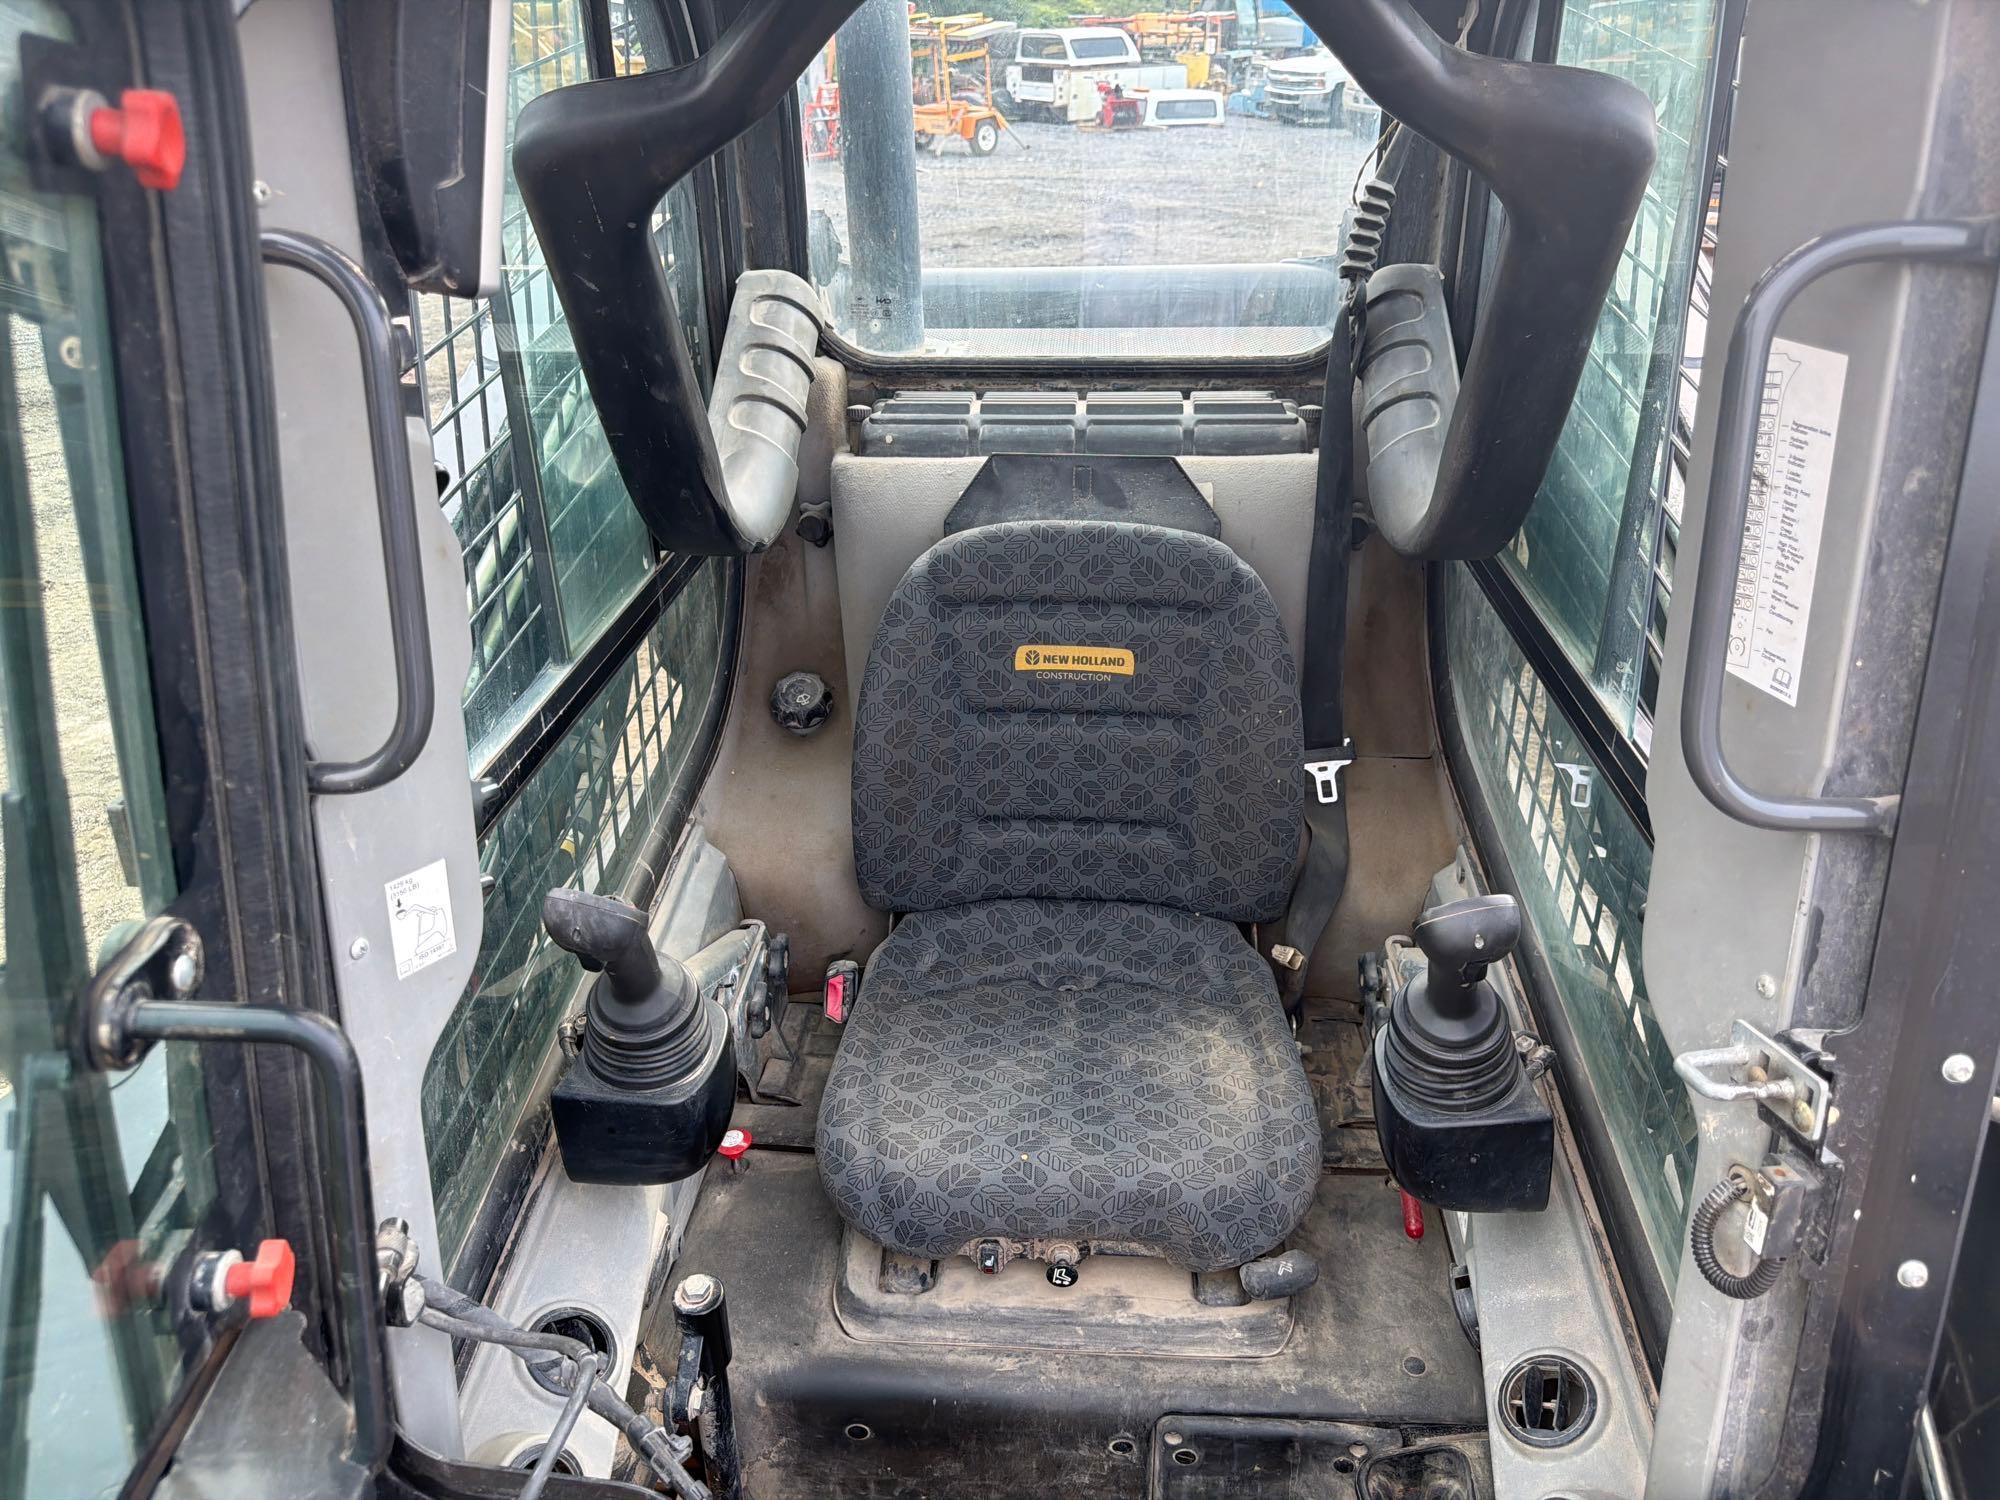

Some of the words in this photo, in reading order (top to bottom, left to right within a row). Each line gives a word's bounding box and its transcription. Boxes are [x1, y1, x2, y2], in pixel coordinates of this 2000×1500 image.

[1043, 654, 1069, 664] NEW
[1072, 655, 1125, 667] HOLLAND
[1036, 671, 1112, 682] CONSTRUCTION
